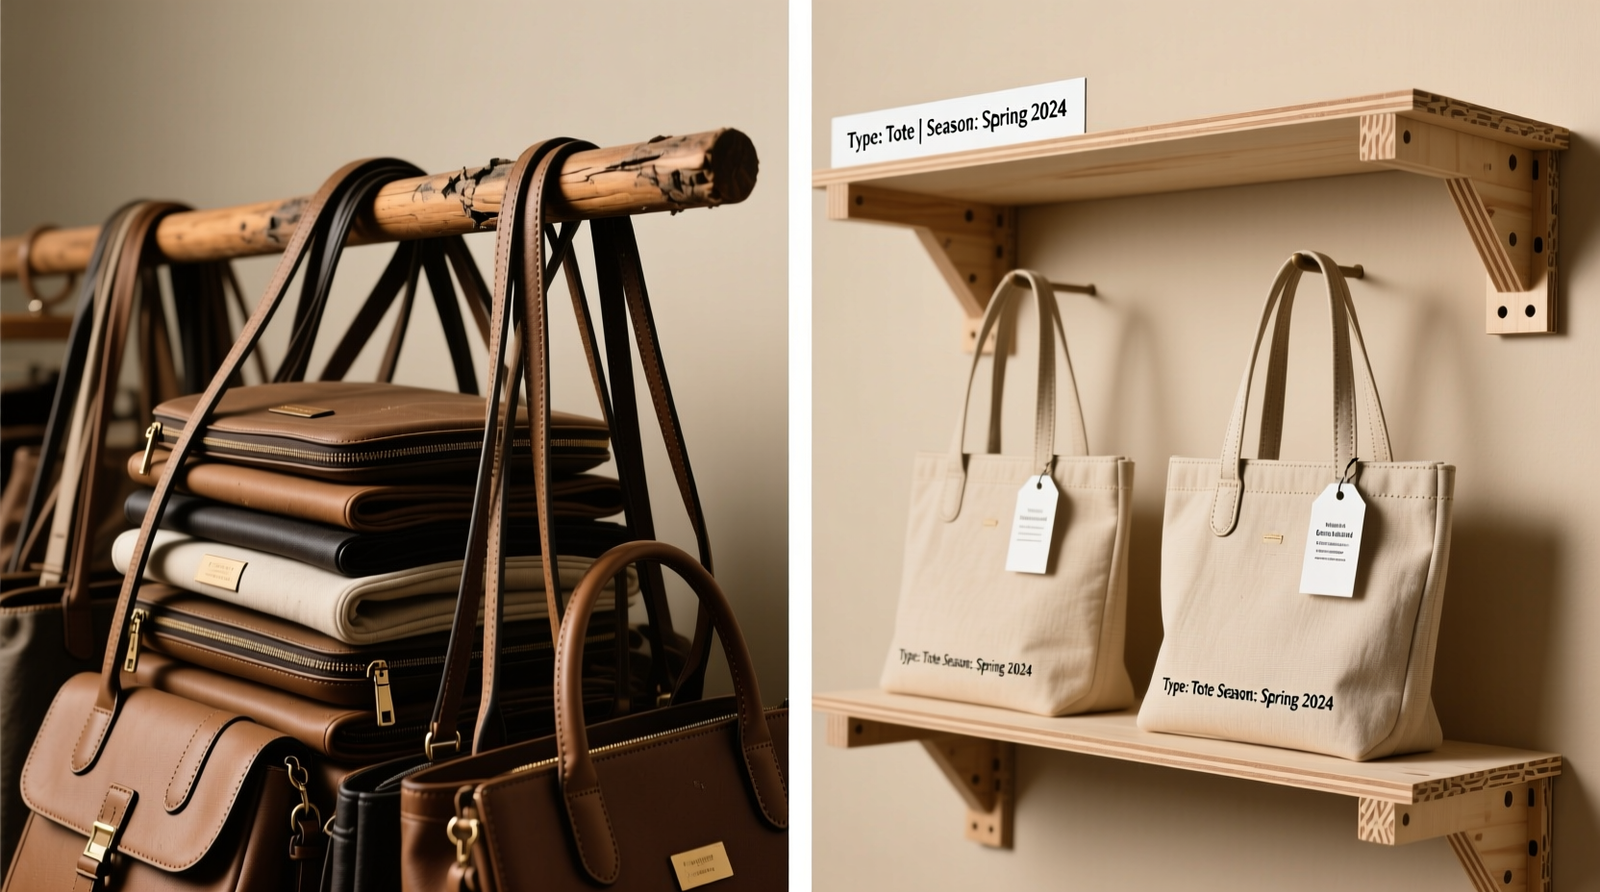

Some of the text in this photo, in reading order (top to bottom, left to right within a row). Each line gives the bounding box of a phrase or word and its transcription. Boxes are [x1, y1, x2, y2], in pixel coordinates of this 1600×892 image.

[847, 131, 883, 153] Type:
[886, 124, 915, 143] Tote
[927, 116, 978, 136] Season:
[982, 107, 1028, 132] Spring
[1031, 98, 1067, 121] 2024
[976, 658, 1005, 677] Spring
[1007, 662, 1032, 677] 2024
[1163, 677, 1189, 696] Type:
[1191, 680, 1215, 696] Tote
[1260, 688, 1299, 711] Spring
[1301, 693, 1334, 711] 2024
